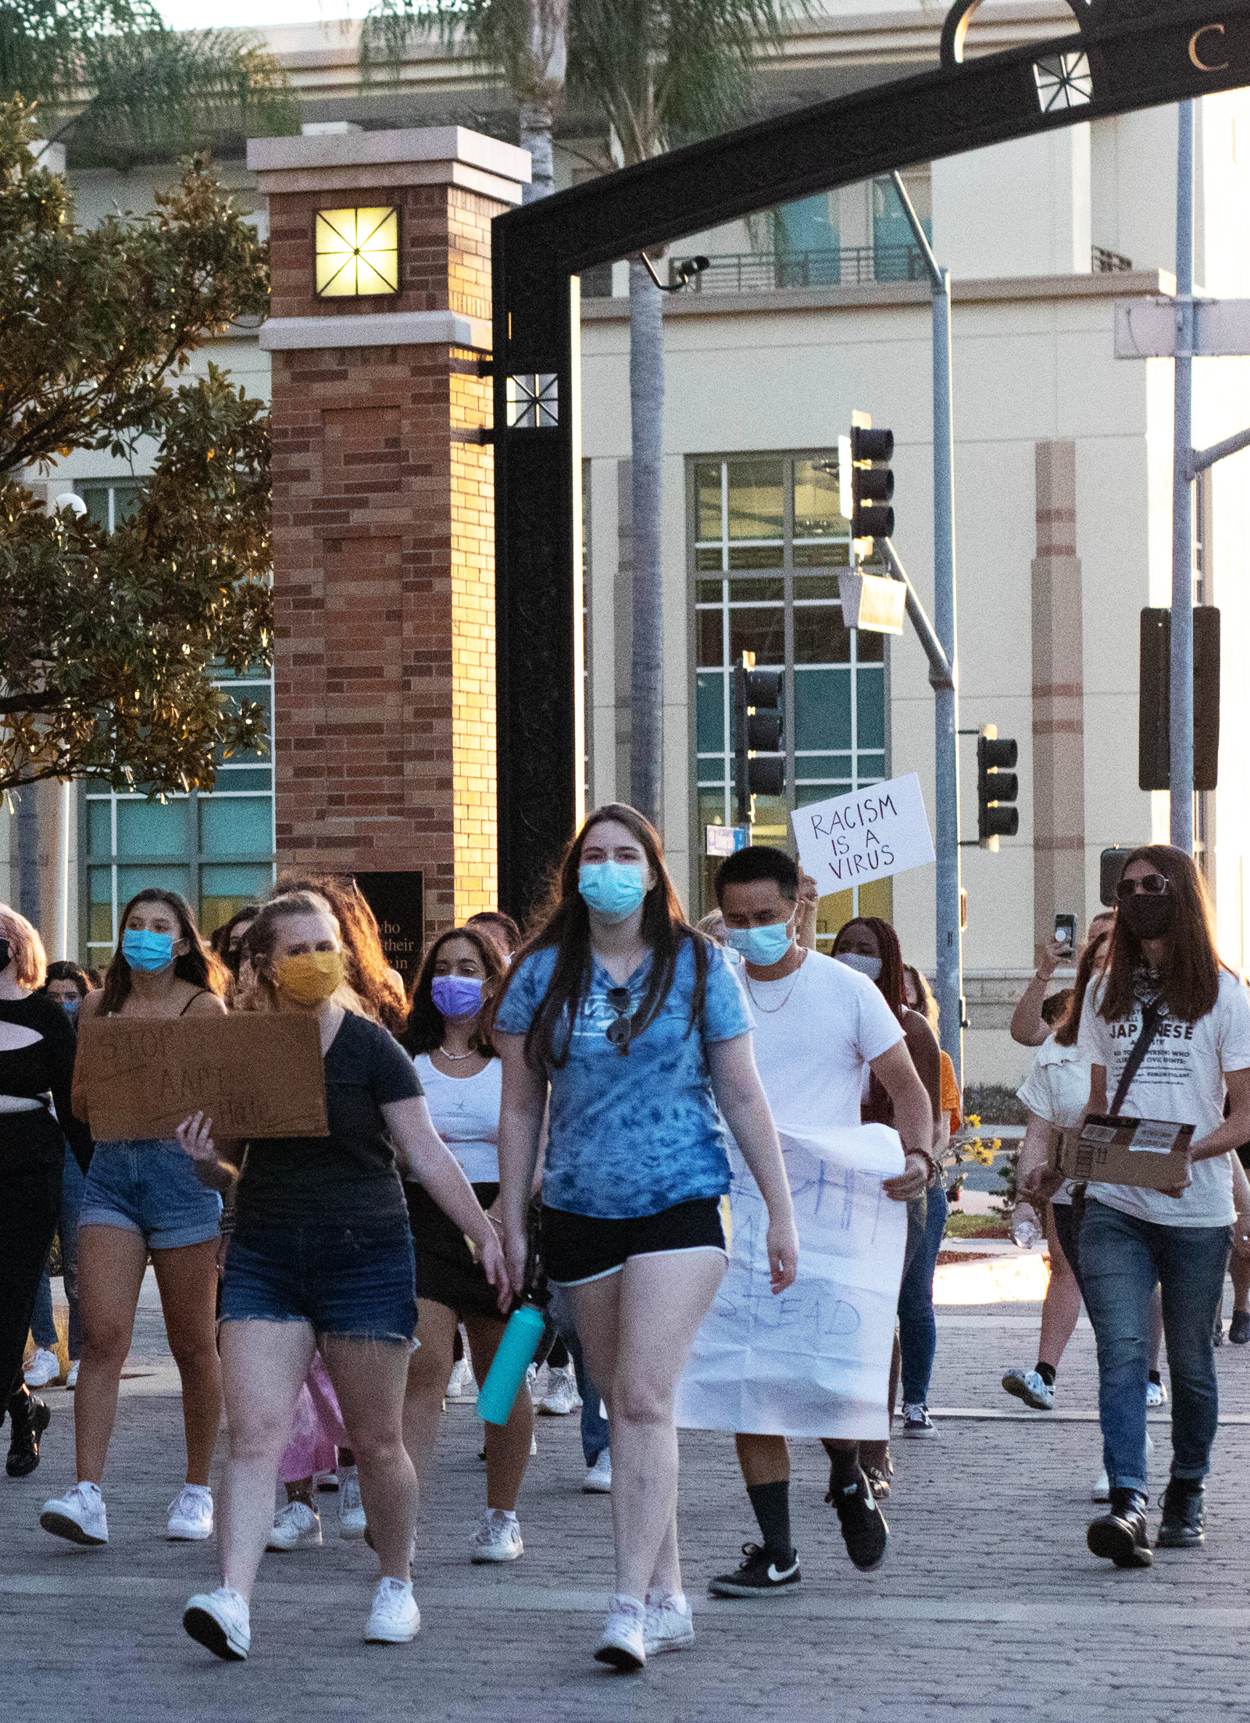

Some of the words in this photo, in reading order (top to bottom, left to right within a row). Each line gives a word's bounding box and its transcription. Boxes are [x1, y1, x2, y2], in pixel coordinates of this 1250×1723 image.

[811, 794, 897, 839] RACISM
[831, 836, 850, 856] IS
[865, 829, 880, 848] A
[828, 845, 895, 880] VIRUS
[383, 938, 415, 952] their
[1110, 1023, 1194, 1040] JAPNESE
